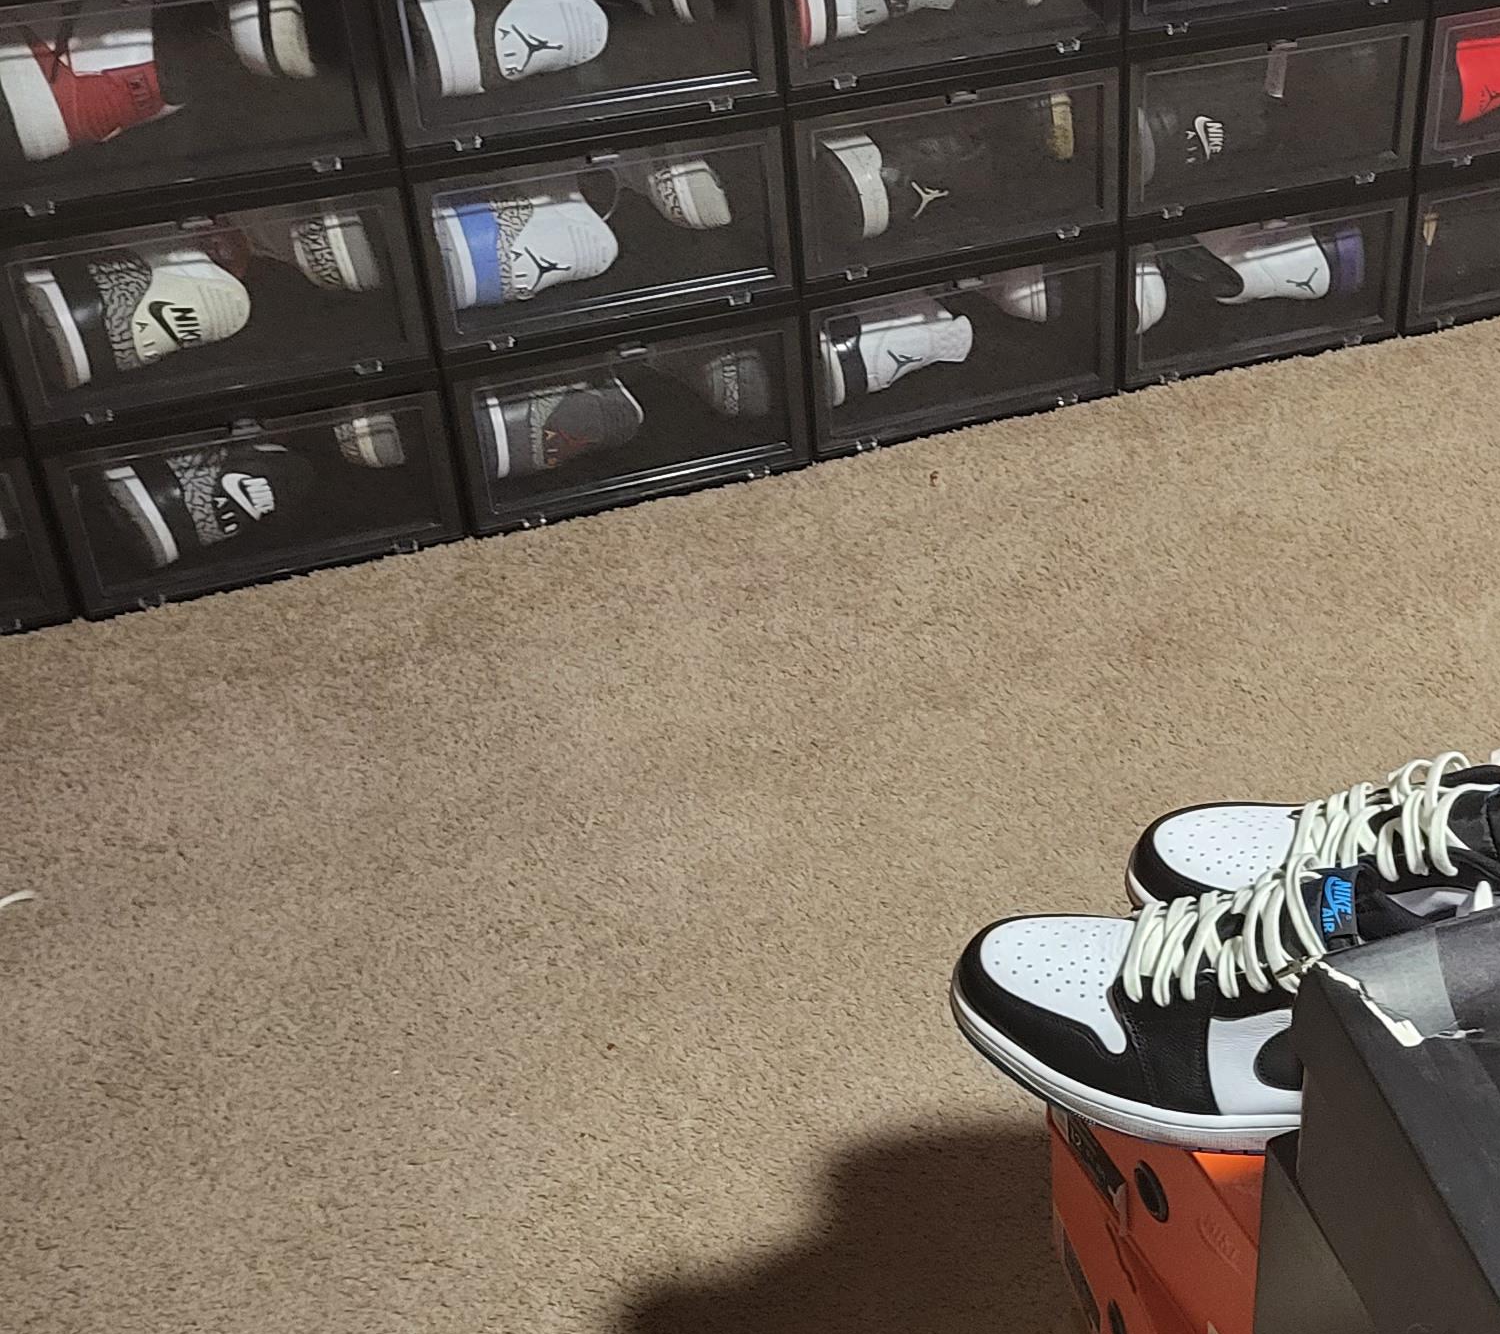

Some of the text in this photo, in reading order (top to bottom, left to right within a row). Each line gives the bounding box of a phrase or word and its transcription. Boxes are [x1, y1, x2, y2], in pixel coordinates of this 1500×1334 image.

[1206, 122, 1223, 154] NIKE
[1333, 879, 1353, 916] NIKE
[1322, 907, 1335, 934] AIR
